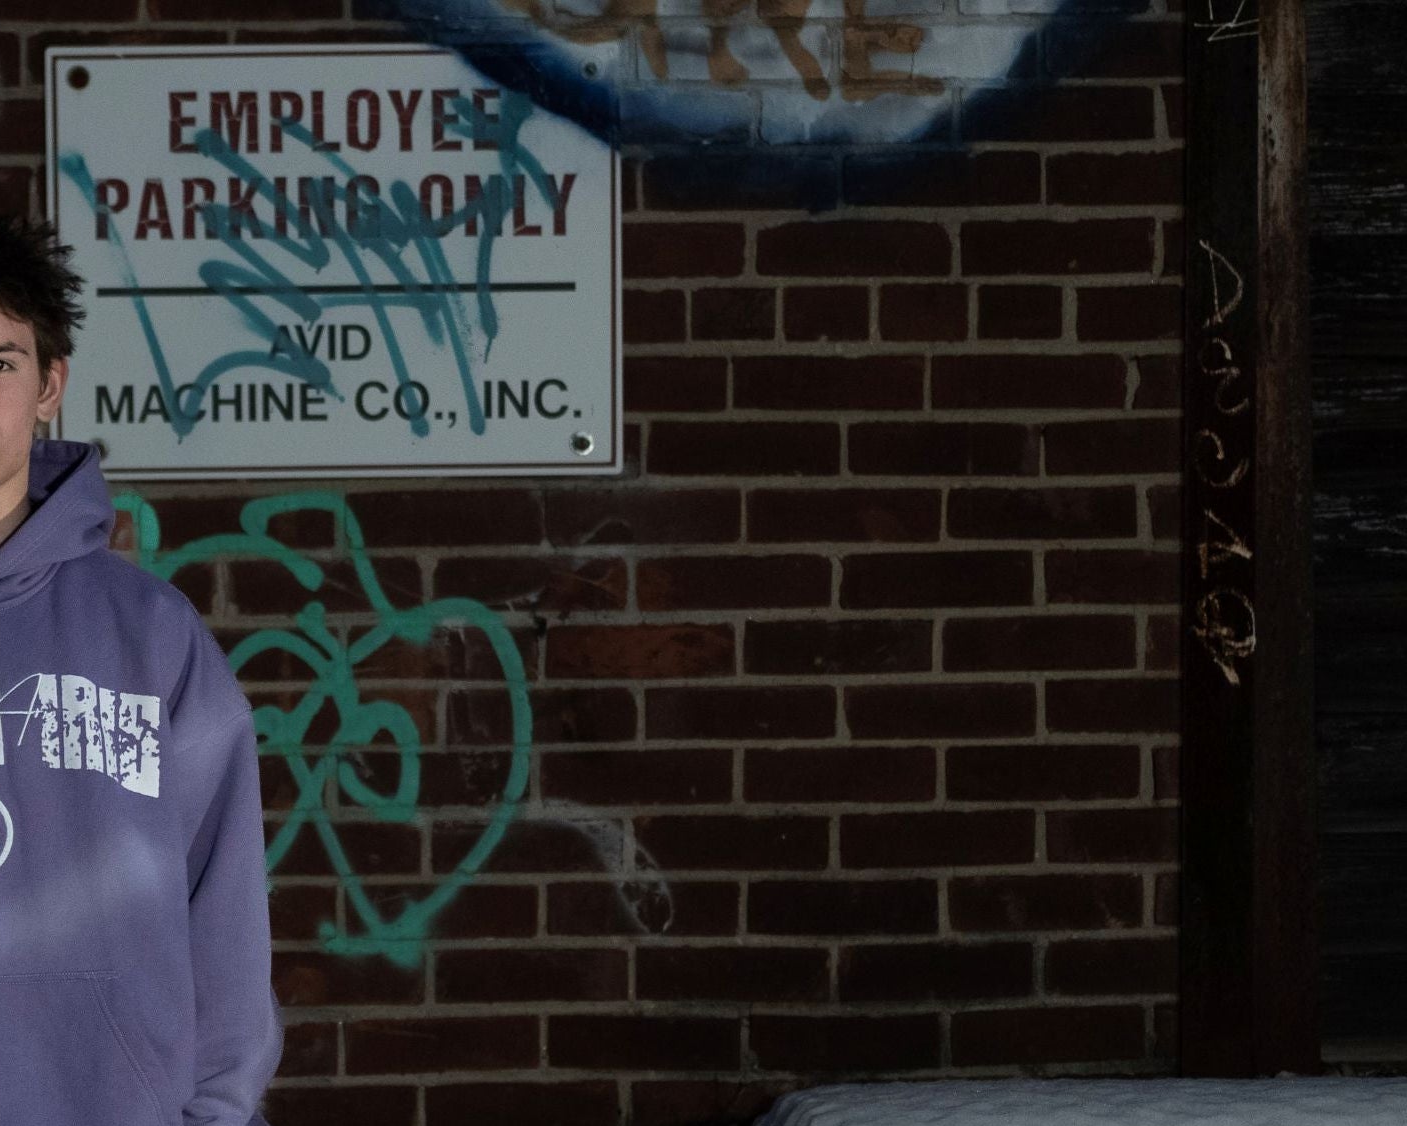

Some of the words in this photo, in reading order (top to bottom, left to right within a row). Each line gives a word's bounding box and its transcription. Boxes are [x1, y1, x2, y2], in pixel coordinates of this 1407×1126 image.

[168, 88, 501, 153] EMPLOYEE
[95, 175, 383, 240] PARKING
[418, 173, 578, 237] ONLY
[268, 324, 373, 362] AVID
[95, 383, 329, 424] MACHINE
[354, 381, 457, 427] CO.,
[483, 377, 583, 420] INC.
